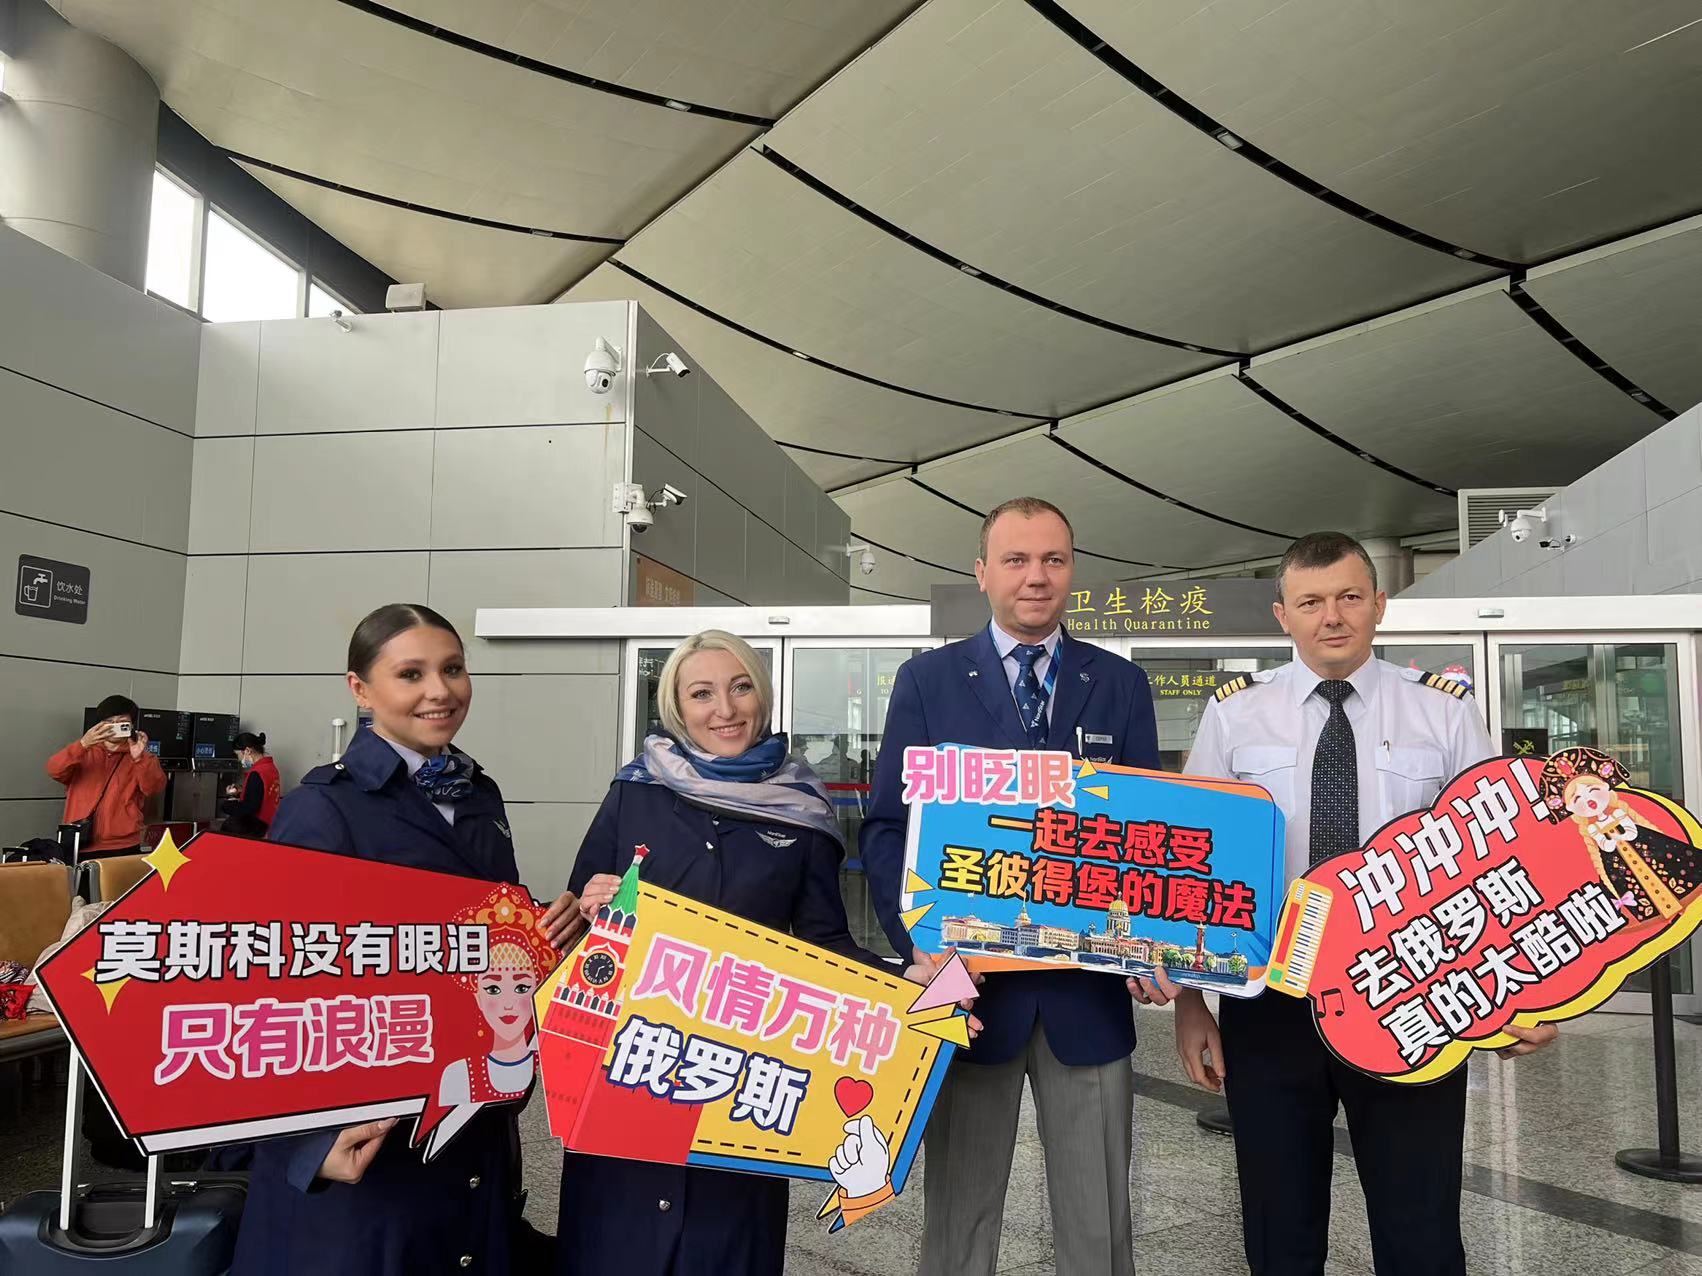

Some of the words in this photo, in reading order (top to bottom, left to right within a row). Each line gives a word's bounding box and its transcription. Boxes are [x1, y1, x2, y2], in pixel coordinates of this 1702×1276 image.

[56, 581, 83, 596] 饮水处
[1065, 585, 1214, 615] 卫生检疫
[1067, 618, 1117, 631] Health
[1124, 618, 1210, 632] Quarantine
[902, 746, 1076, 808] 别眨眼
[989, 808, 1212, 873] 一起去感受
[940, 845, 1257, 931] 圣彼得堡的魔法
[96, 920, 490, 983] 莫斯科没有眼泪
[1349, 856, 1545, 1009] 去俄罗斯
[630, 933, 902, 1075] 风情万种
[1380, 881, 1629, 1065] 真的太酷啦
[153, 994, 434, 1087] 只有浪漫
[605, 1014, 812, 1135] 俄罗斯
